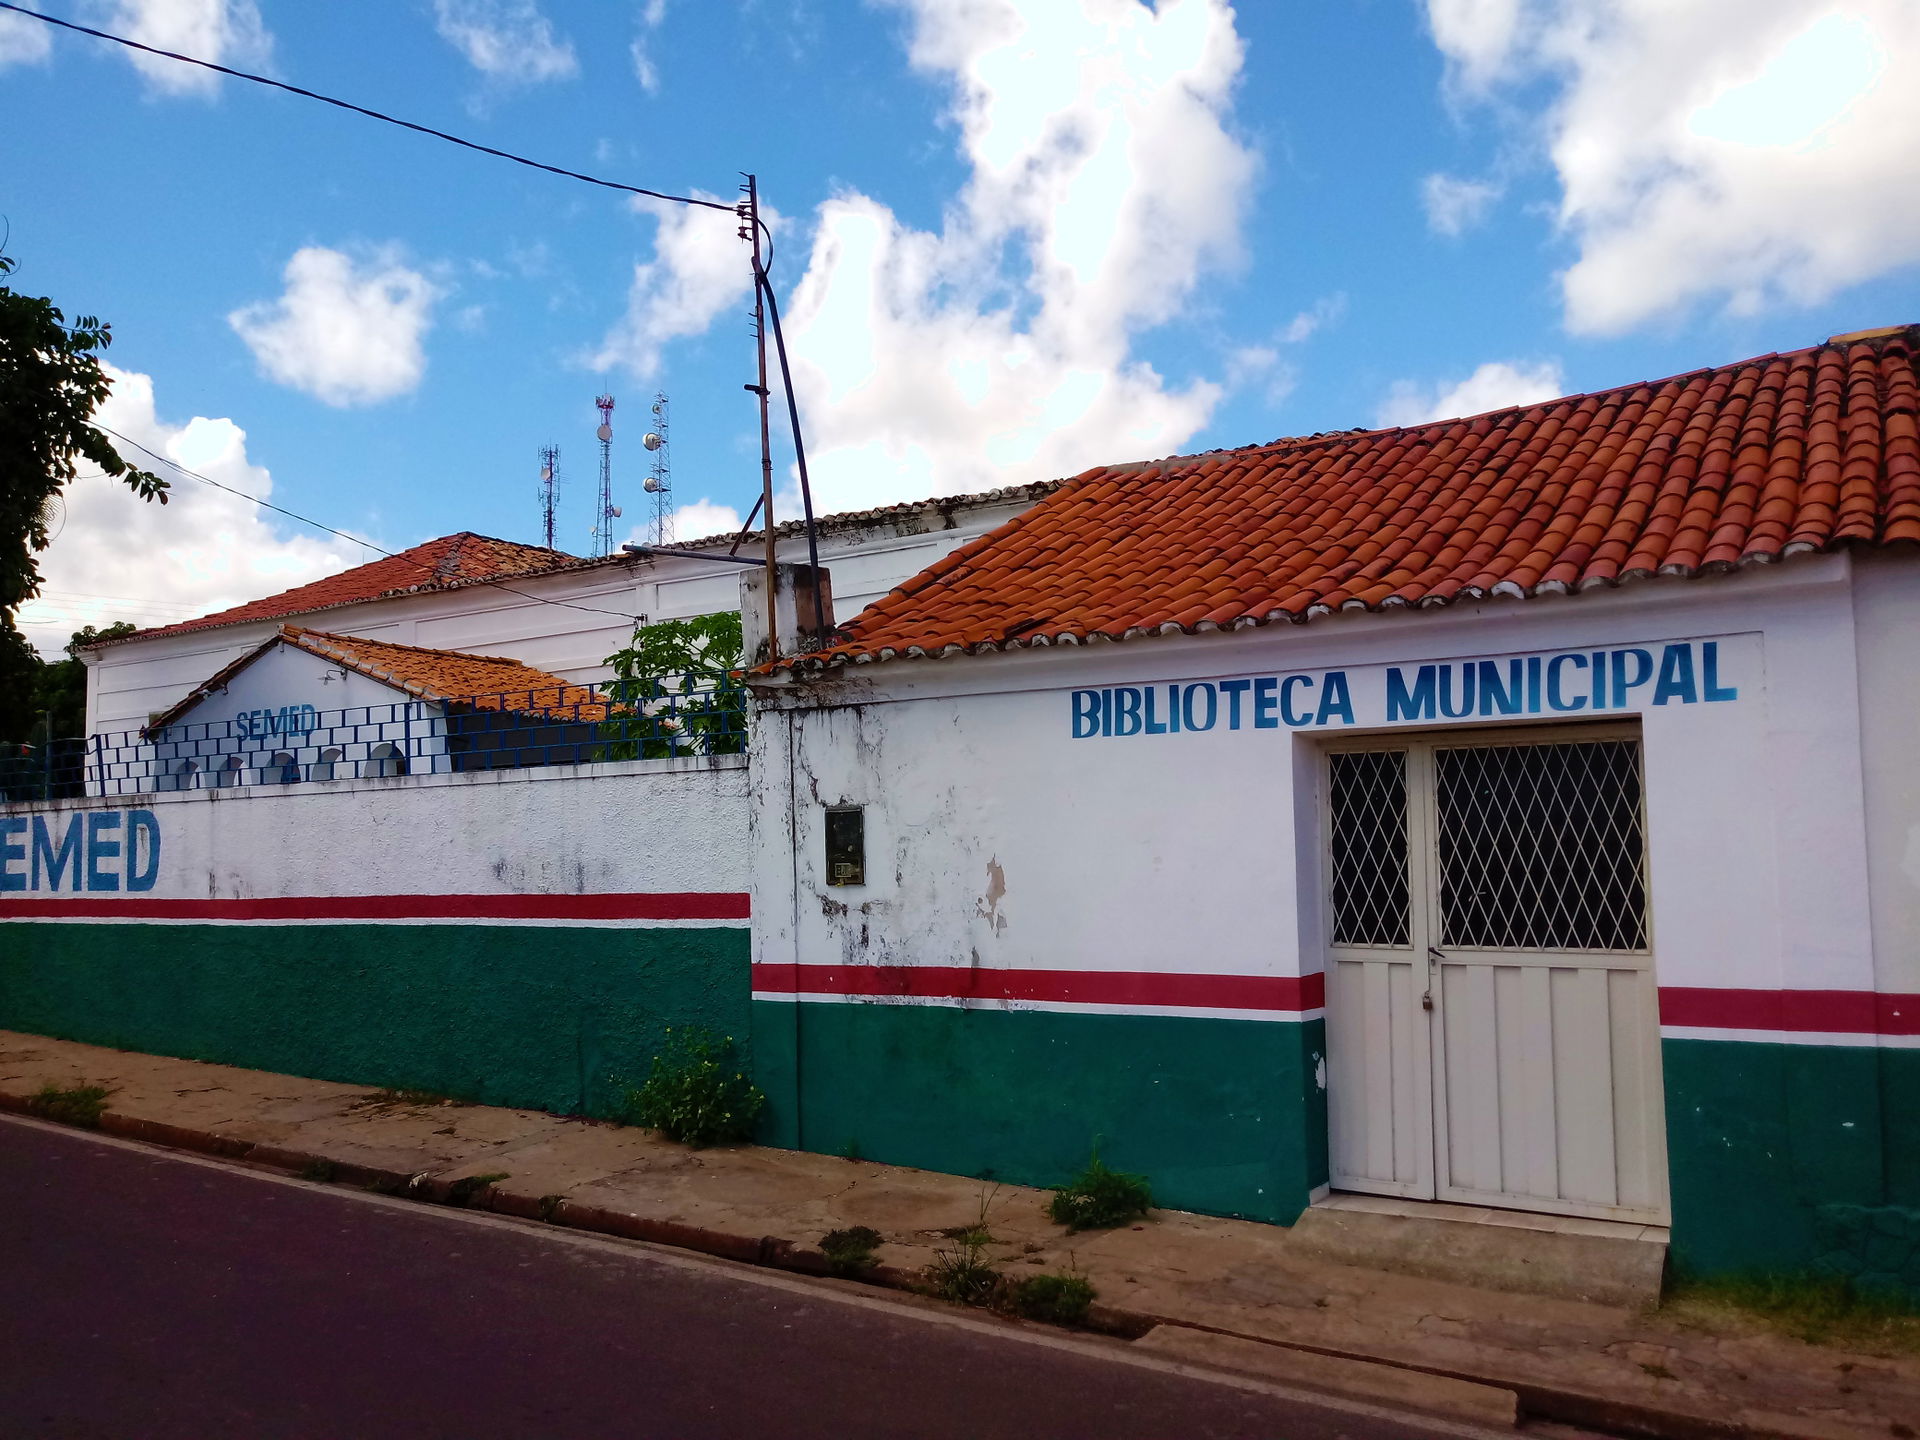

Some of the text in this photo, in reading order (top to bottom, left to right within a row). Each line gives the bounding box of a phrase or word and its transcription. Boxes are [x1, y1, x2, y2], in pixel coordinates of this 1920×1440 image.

[236, 703, 316, 741] SEMED
[1072, 642, 1738, 738] BIBLIOTECA MUNICIPAL
